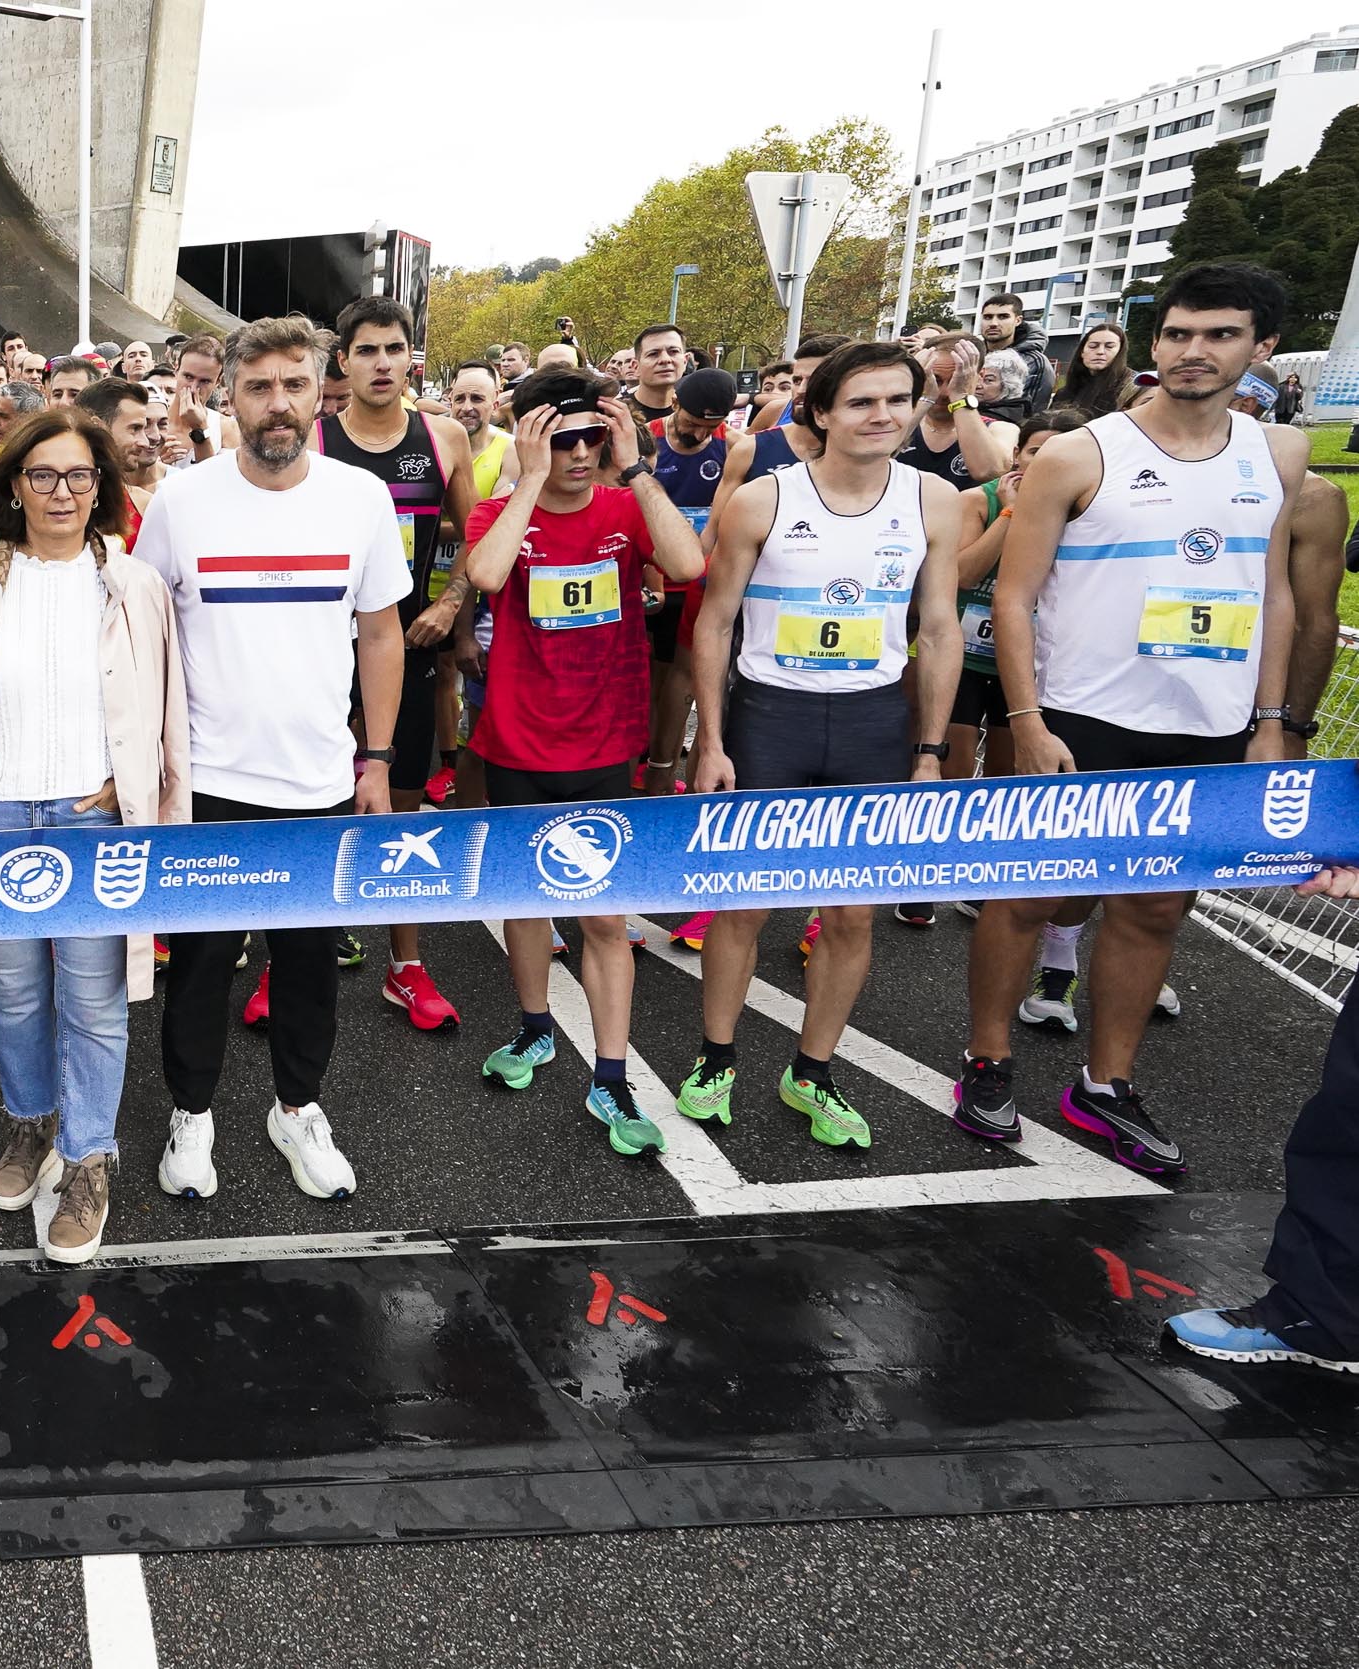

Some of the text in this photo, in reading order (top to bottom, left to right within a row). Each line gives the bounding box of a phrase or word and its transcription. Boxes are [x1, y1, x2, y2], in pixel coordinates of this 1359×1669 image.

[258, 573, 293, 581] SPIKES
[563, 580, 592, 607] 61
[1191, 606, 1212, 634] 5
[820, 621, 841, 649] 6
[686, 779, 1196, 852] XLII GRAN FONDO CAIXABANK 24
[528, 807, 633, 847] SOCIEDAD GIMNÁSTICA
[7, 852, 60, 867] DEPORTE
[161, 854, 240, 870] Concello
[1243, 851, 1313, 864] Concello
[159, 869, 291, 888] de Pontevedra
[682, 871, 734, 894] XXIX
[737, 869, 806, 892] MEDIO
[809, 860, 919, 890] MARATÓN
[923, 864, 951, 885] DE
[954, 858, 1098, 884] PONTEVEDRA
[1214, 862, 1324, 879] de Pontevedra
[2, 876, 62, 902] PONTEVEDRA
[359, 879, 452, 899] CaixaBank
[538, 879, 612, 901] PONTEVEDRA
